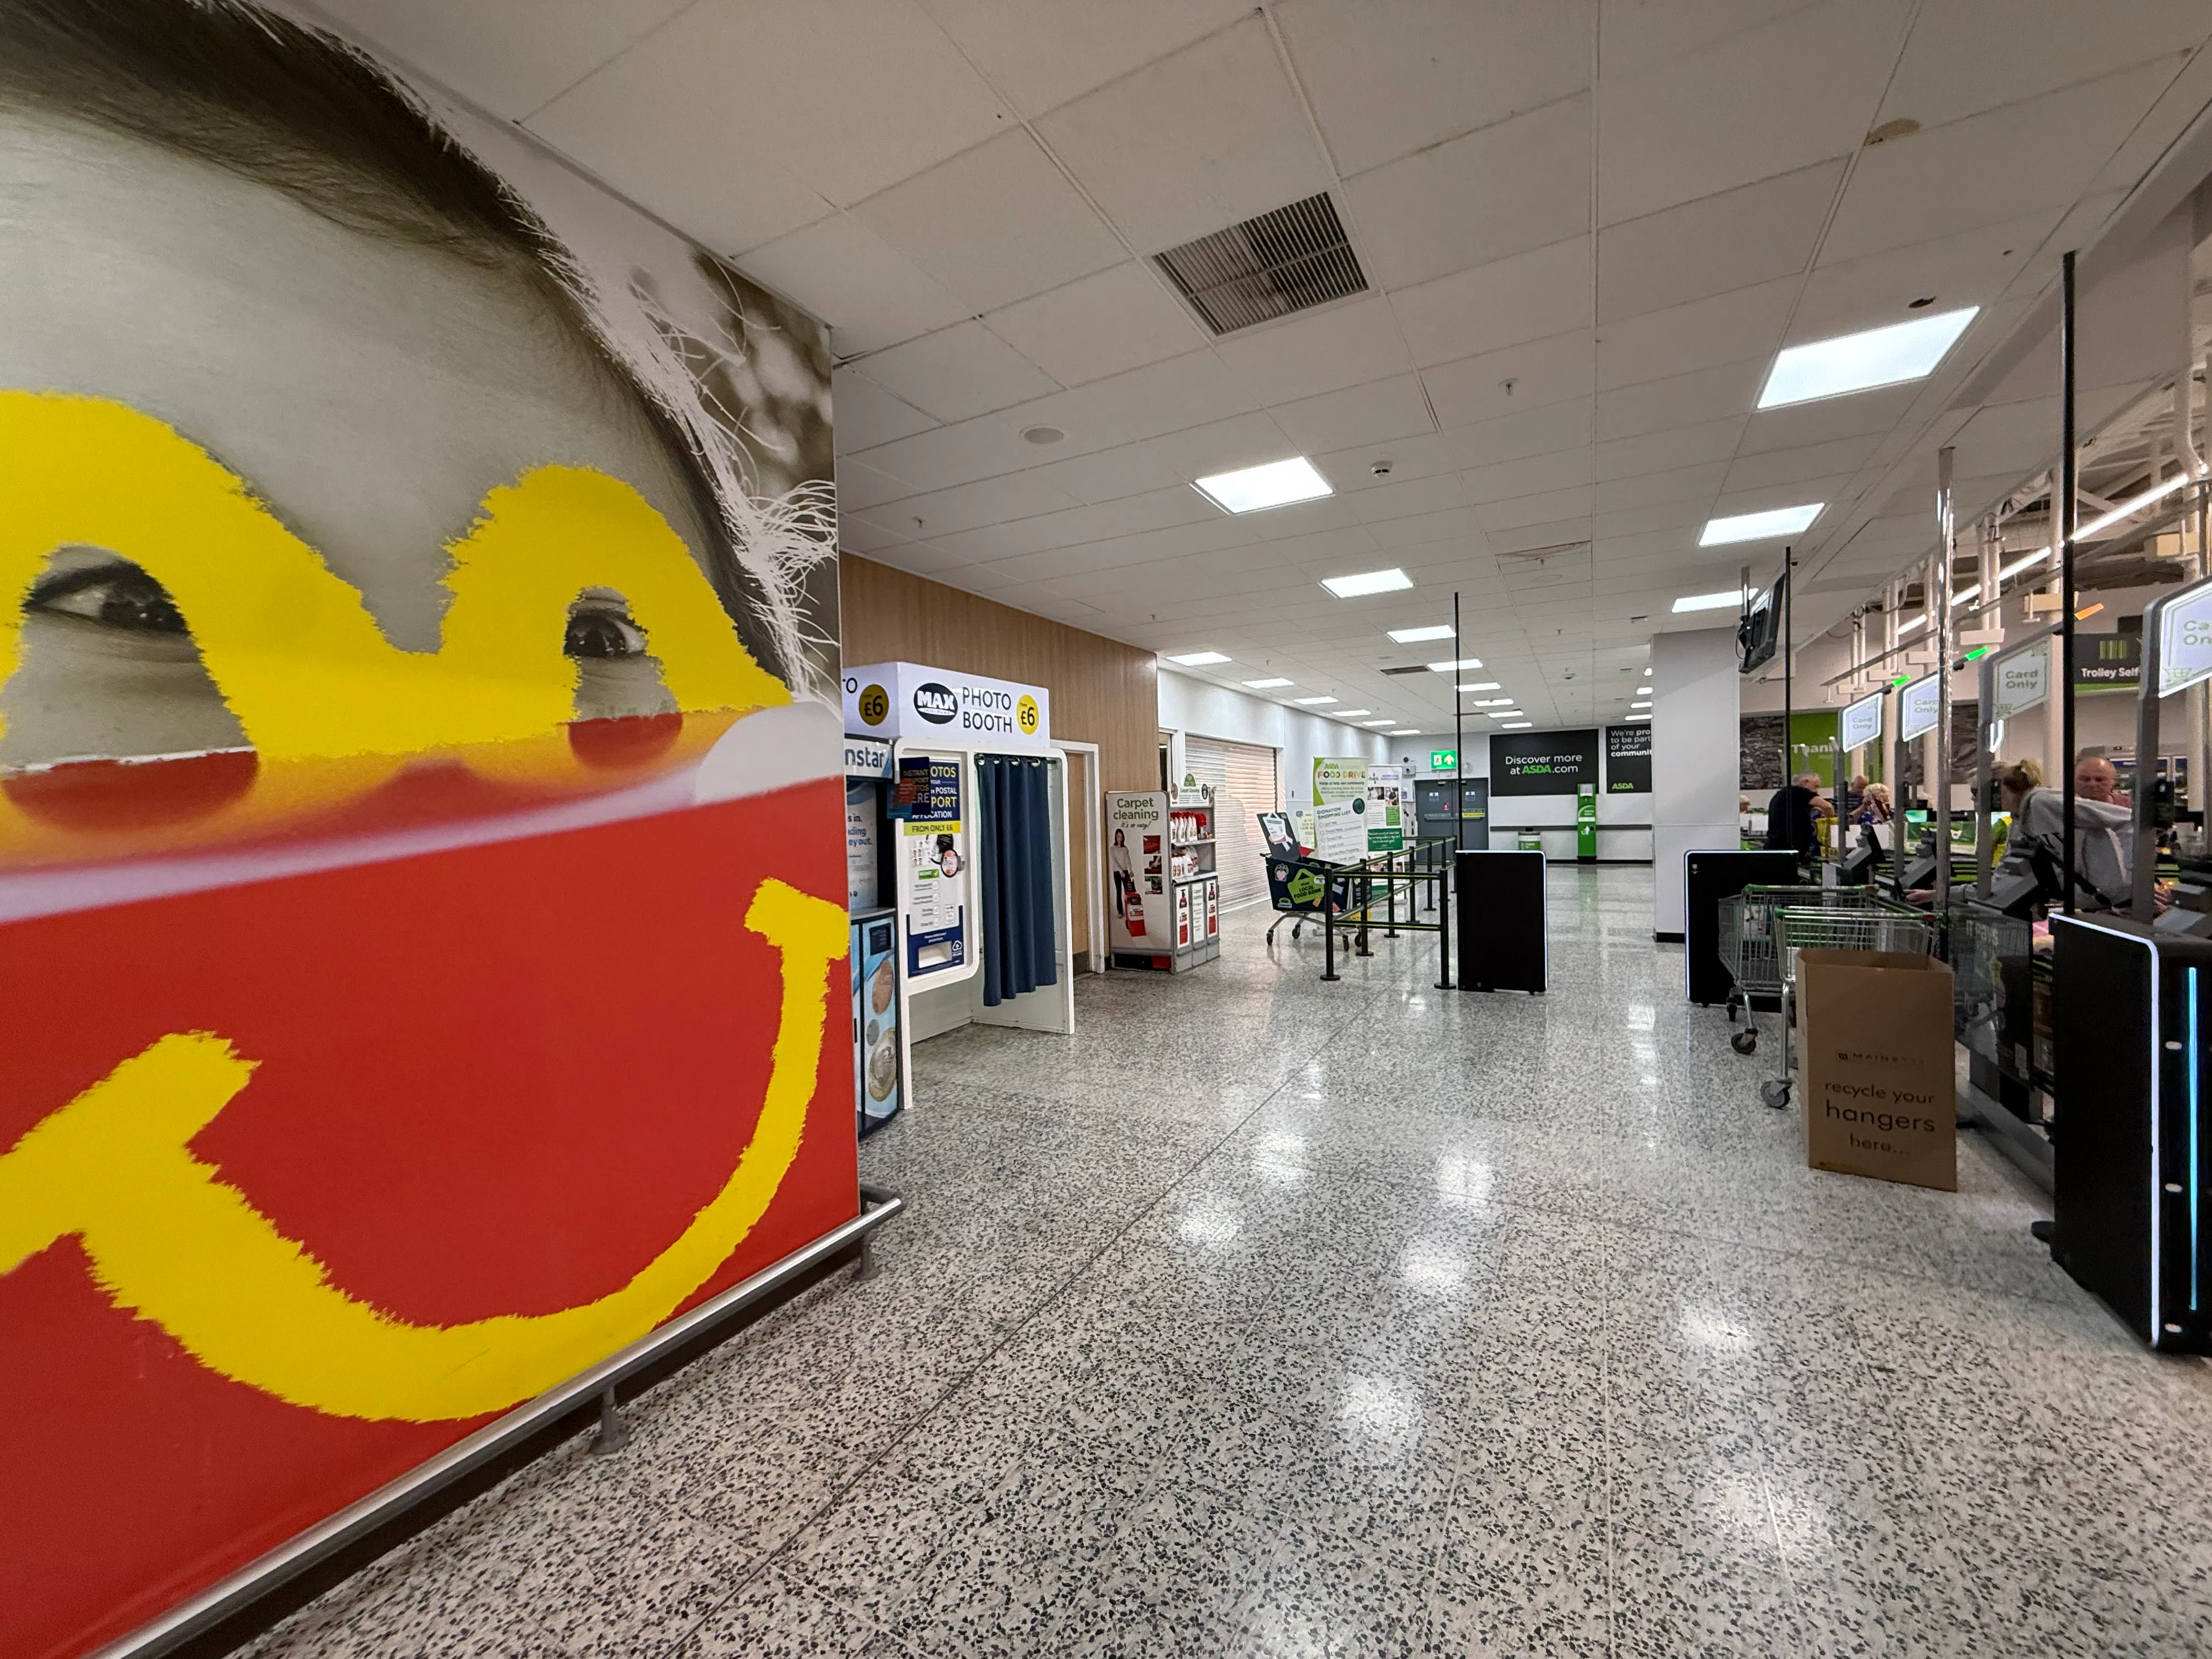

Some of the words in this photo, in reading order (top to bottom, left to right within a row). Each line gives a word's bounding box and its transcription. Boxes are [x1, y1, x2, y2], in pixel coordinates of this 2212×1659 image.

[2005, 669, 2038, 679] Card
[2081, 667, 2117, 679] Trolley
[842, 678, 857, 694] O
[2006, 680, 2038, 689] Only
[864, 695, 883, 716] £6
[917, 690, 955, 710] MAX
[962, 686, 1012, 710] PHOTO
[963, 712, 1012, 733] BOOTH
[1020, 706, 1035, 727] £6
[845, 747, 884, 768] nstar
[1505, 756, 1551, 765] Discover
[1522, 765, 1578, 774] ASDA.com
[1117, 797, 1154, 810] Carpet
[1113, 809, 1159, 821] cleaning
[1317, 812, 1341, 820] SHOPPING
[1825, 1081, 1887, 1098] recycle
[1892, 1091, 1936, 1104] your
[1825, 1098, 1936, 1133] hangers
[1849, 1132, 1910, 1155] here...
